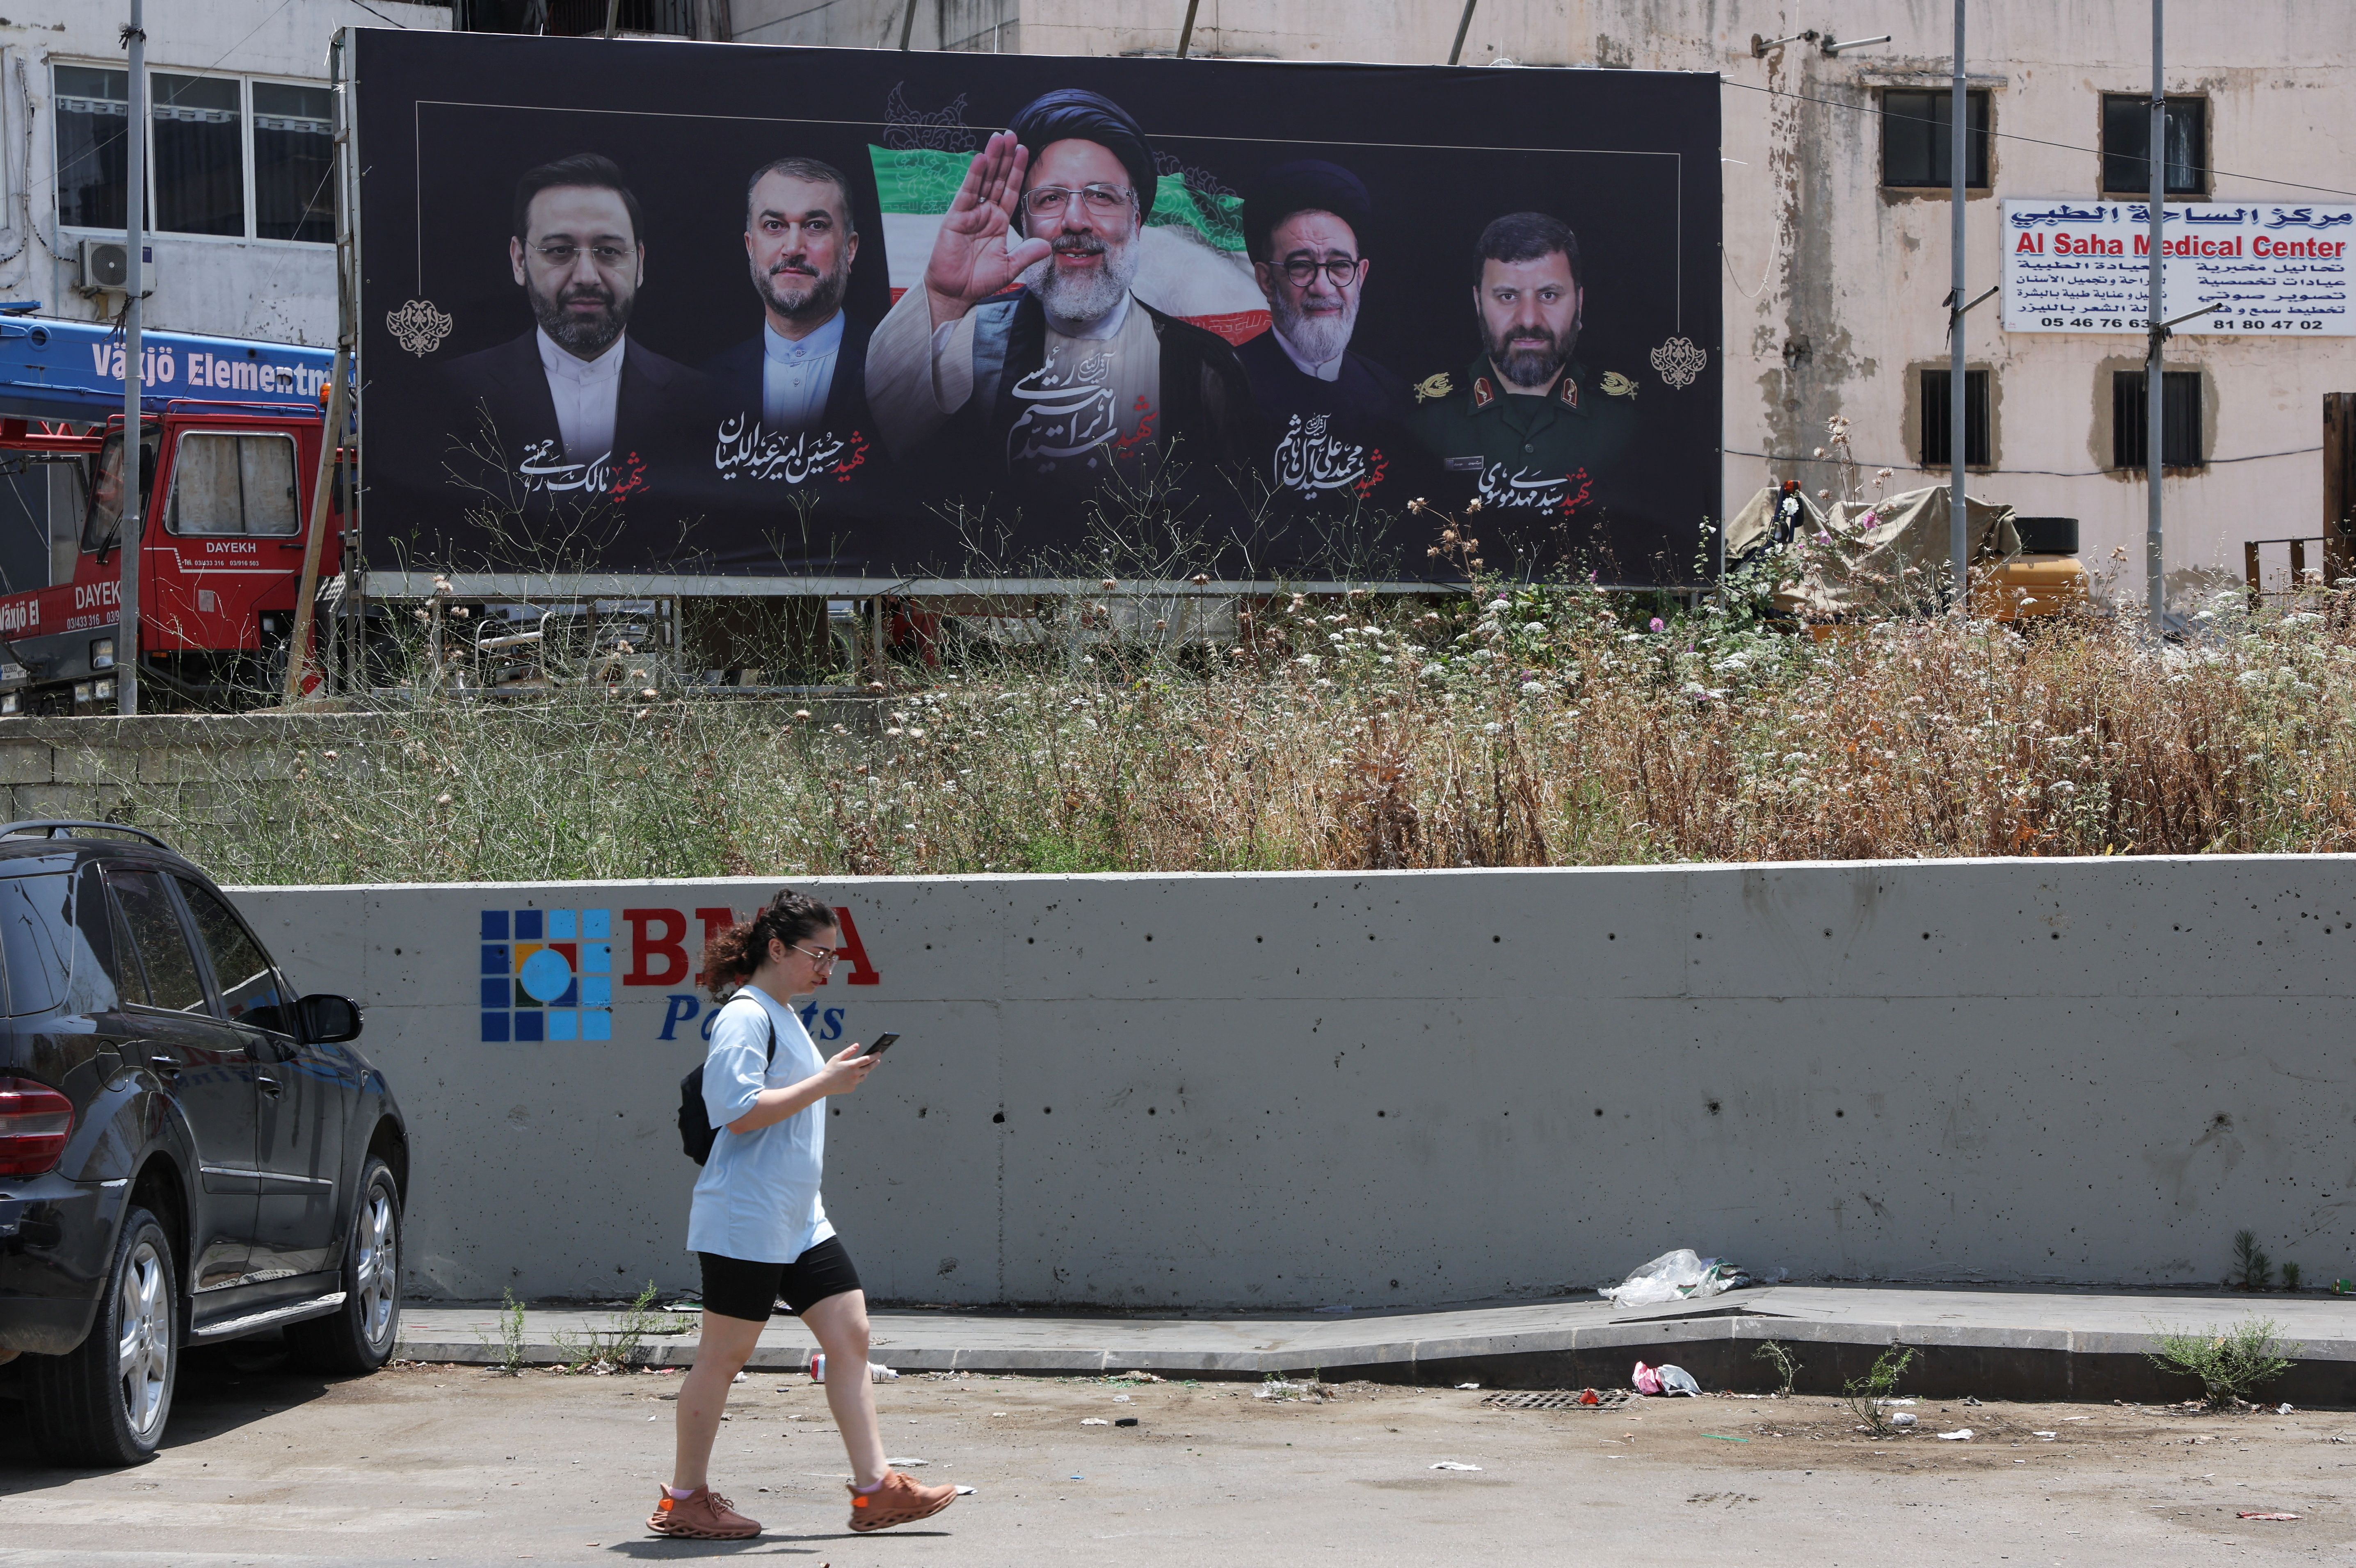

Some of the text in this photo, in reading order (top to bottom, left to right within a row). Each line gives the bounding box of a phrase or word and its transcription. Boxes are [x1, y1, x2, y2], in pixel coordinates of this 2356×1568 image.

[2011, 205, 2353, 227] مركز الساحة الطبي
[2016, 232, 2346, 257] Al Saha Medical Center
[2017, 260, 2167, 272] اعيادة الطبية
[2196, 263, 2345, 274] تحاليل مخبرية
[2068, 276, 2116, 286] وتجميل
[2197, 277, 2346, 288] عيادات تخصصية
[2017, 288, 2060, 299] بالبشرة
[2062, 289, 2091, 300] طبية
[2093, 289, 2124, 300] عناية
[2198, 292, 2346, 302] تصوير صوتي
[2078, 304, 2126, 313] الشعر
[2249, 308, 2281, 316] سمع
[2287, 306, 2346, 316] تخطيط
[2041, 317, 2149, 328] 05 46 76 63
[2214, 320, 2323, 330] 81 80 47 02
[206, 542, 256, 553] DAYEKH
[75, 580, 121, 610] DAYEK
[67, 609, 120, 630] 03/433 316 03/9
